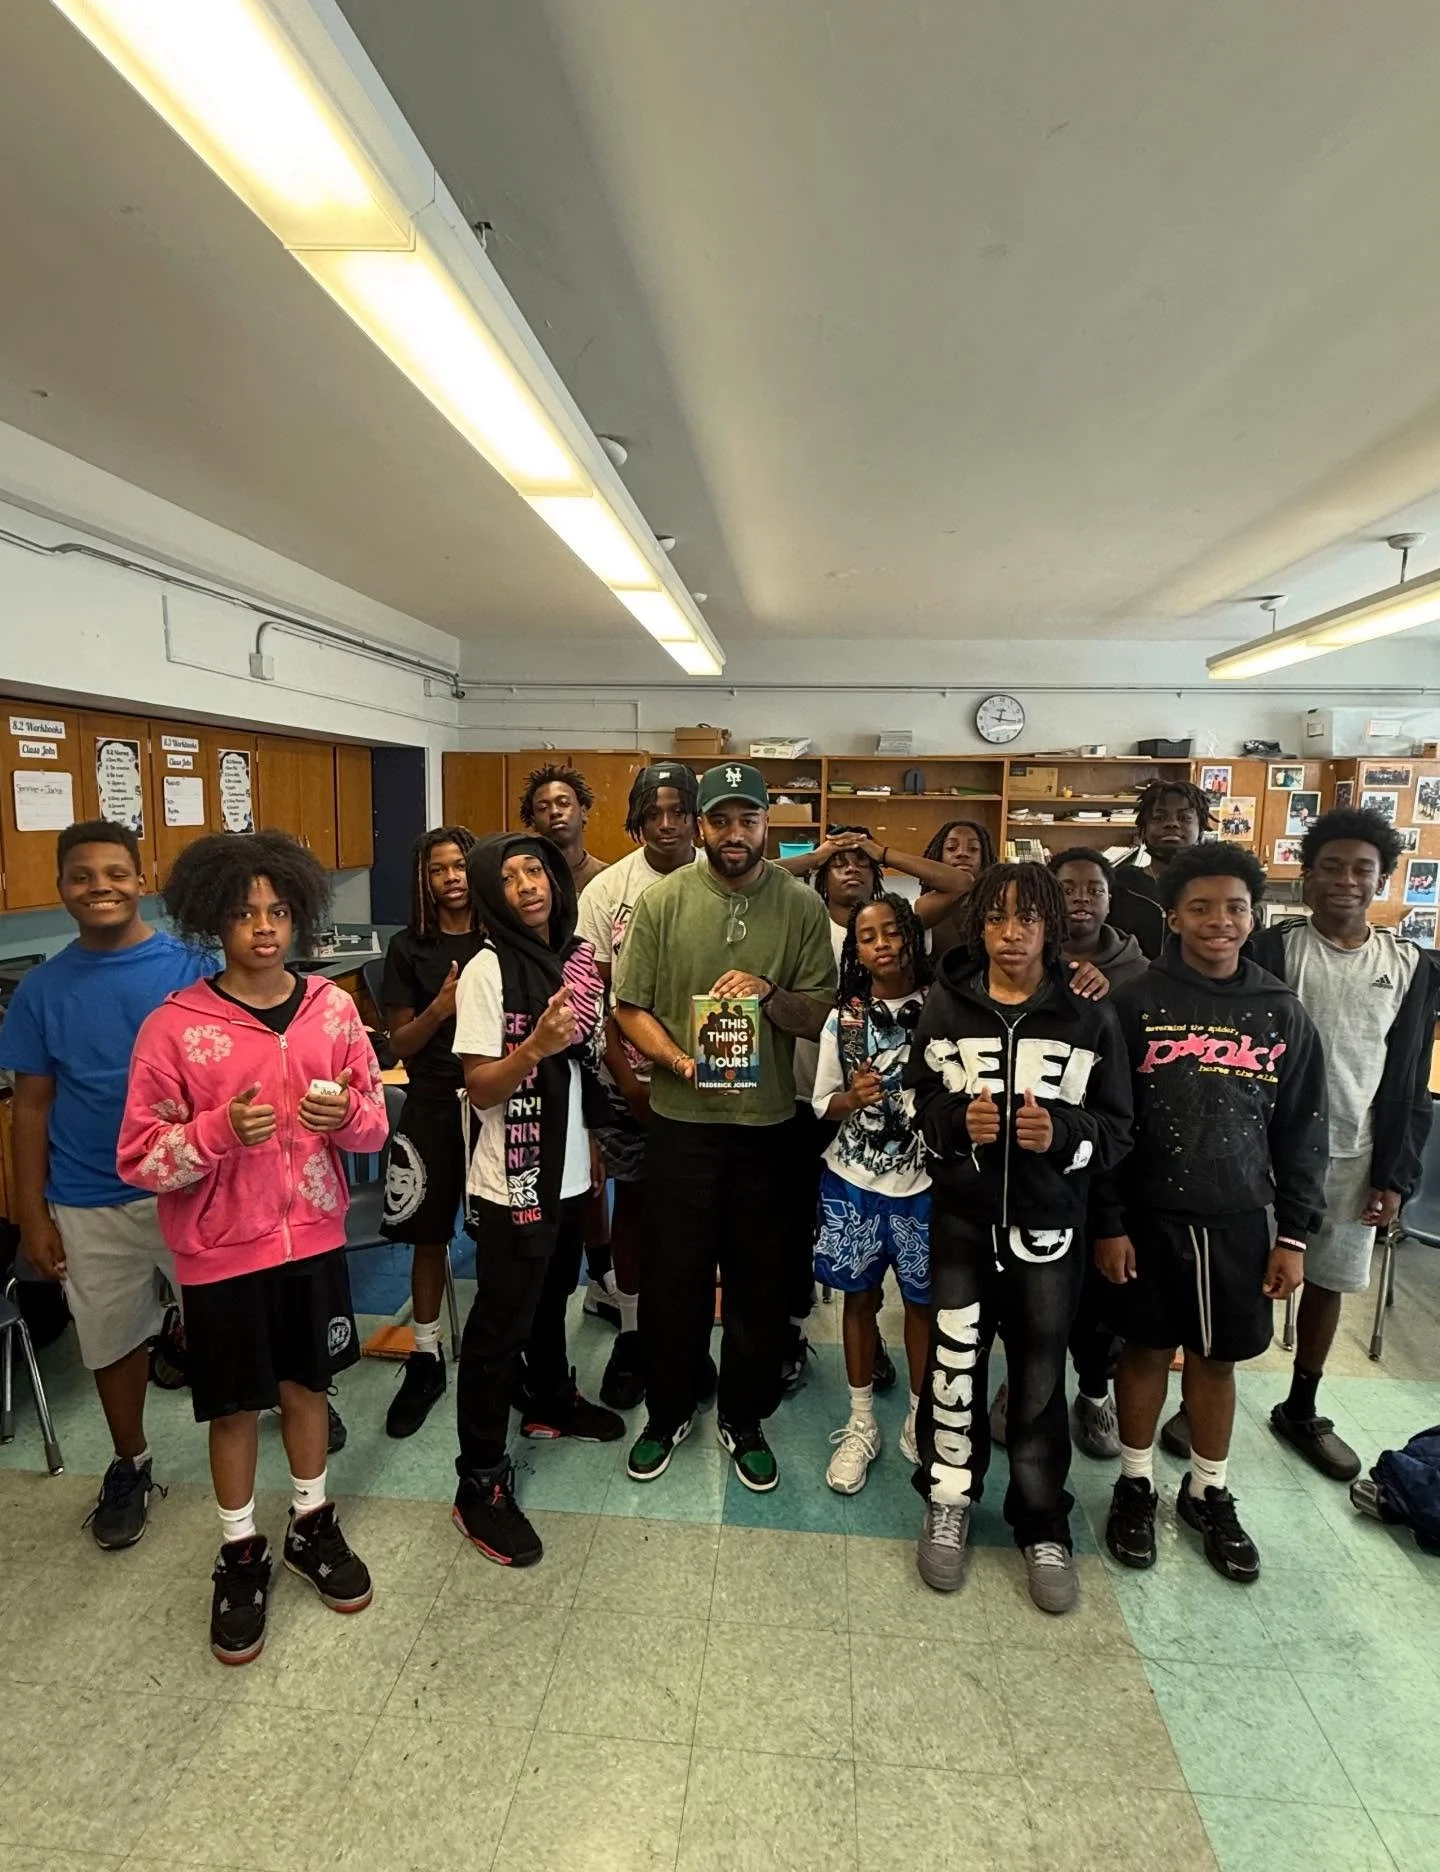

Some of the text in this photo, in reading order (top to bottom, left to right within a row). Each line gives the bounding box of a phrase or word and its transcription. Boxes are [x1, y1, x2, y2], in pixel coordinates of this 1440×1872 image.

[26, 722, 63, 734] Workbooks
[22, 744, 40, 753] Class
[719, 1019, 748, 1029] THIS
[707, 1032, 748, 1042] THING
[731, 1045, 748, 1055] OF
[715, 1058, 749, 1068] OURS
[698, 1081, 757, 1089] FREDERICK JOSEPH
